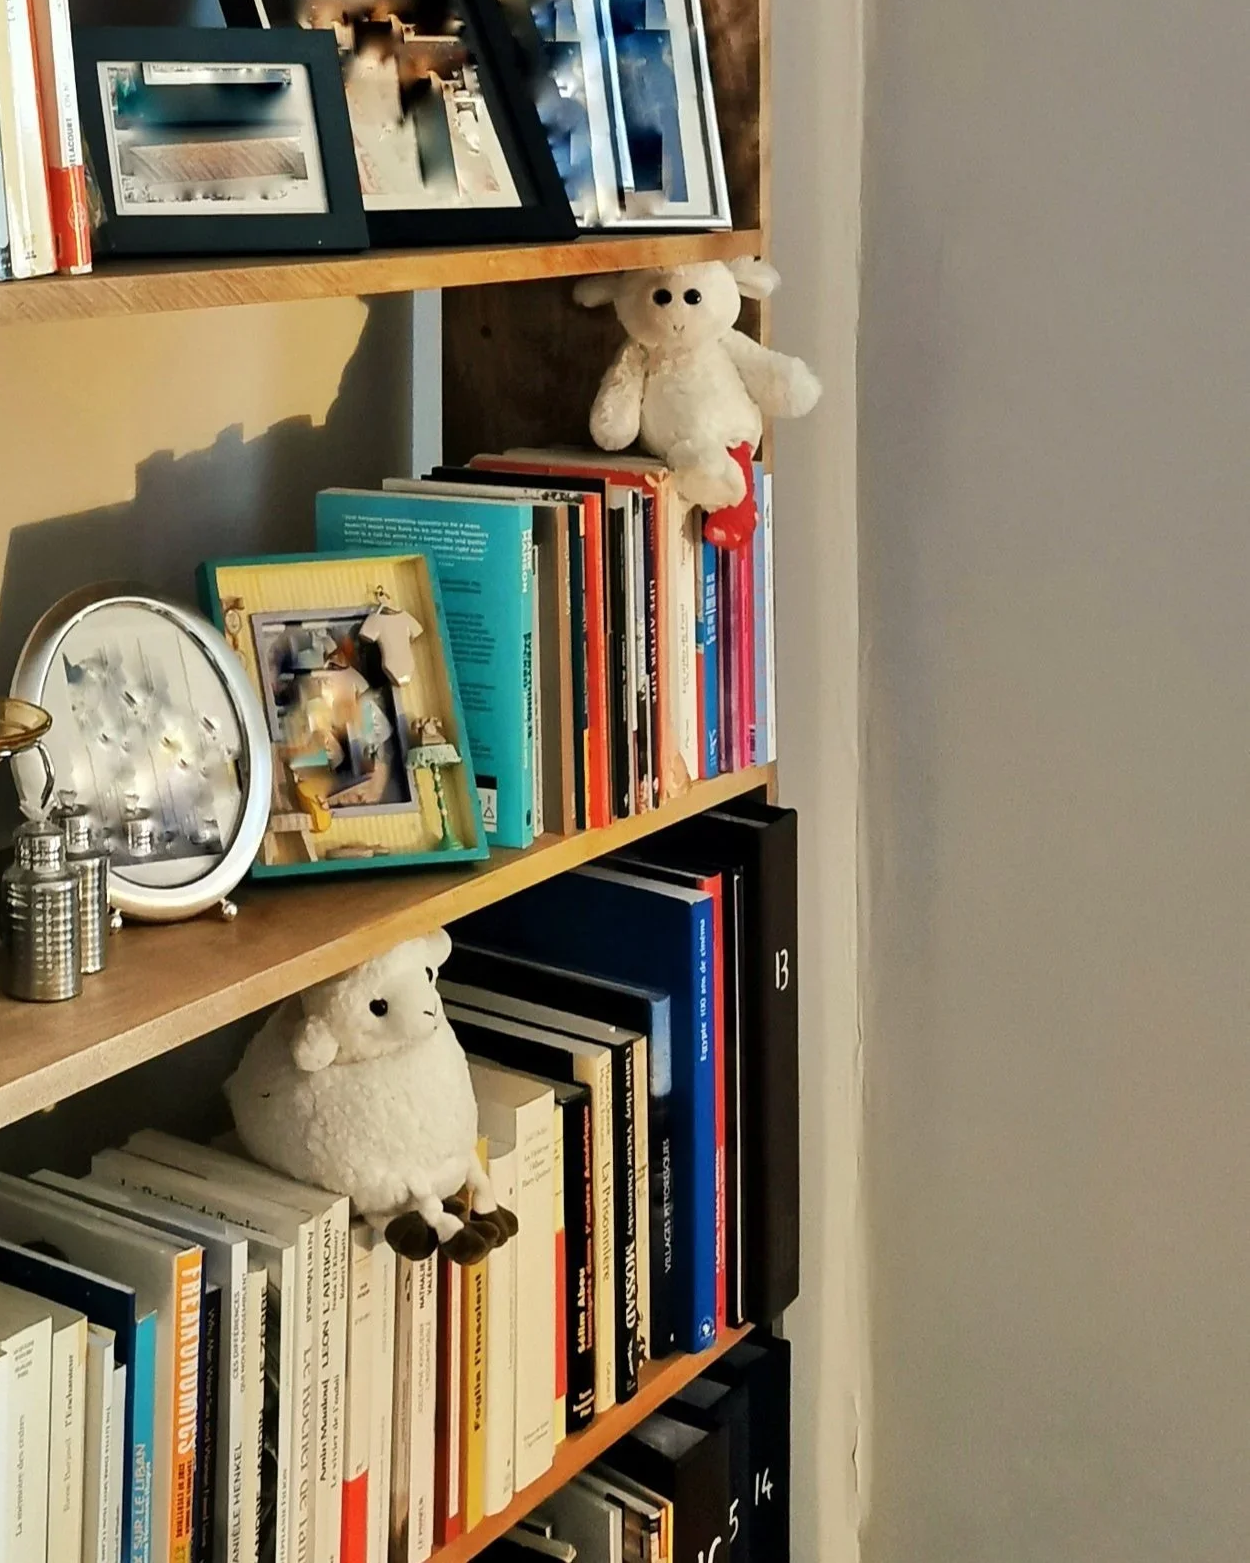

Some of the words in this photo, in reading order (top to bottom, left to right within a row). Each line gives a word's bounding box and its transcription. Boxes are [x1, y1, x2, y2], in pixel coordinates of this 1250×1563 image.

[699, 918, 707, 957] cinéma
[699, 960, 707, 974] de
[699, 976, 707, 995] ans
[699, 997, 707, 1018] 100
[700, 1022, 708, 1062] Egypte
[625, 1046, 634, 1088] Claire
[625, 1091, 634, 1119] Hoy
[625, 1124, 633, 1167] Victor
[601, 1162, 611, 1186] La
[601, 1189, 612, 1283] Prisonnière
[321, 1219, 331, 1315] L'AFRICAIN
[418, 1261, 426, 1309] NATHALIE
[577, 1267, 586, 1307] Abou
[625, 1239, 636, 1329] MOSSAD
[473, 1272, 483, 1366] l'Insolent
[178, 1264, 201, 1455] FREAKONOMICS
[206, 1339, 215, 1361] Men
[319, 1378, 330, 1439] Maalouf
[473, 1369, 482, 1431] Foglia
[203, 1421, 212, 1442] and
[16, 1451, 24, 1470] des
[134, 1443, 146, 1492] LIBAN
[232, 1441, 243, 1506] HENKEL
[319, 1442, 328, 1482] Amin
[14, 1473, 24, 1520] mémoire
[134, 1495, 145, 1514] LE
[754, 1467, 774, 1506] 14
[14, 1522, 23, 1537] La
[133, 1519, 144, 1551] SUR
